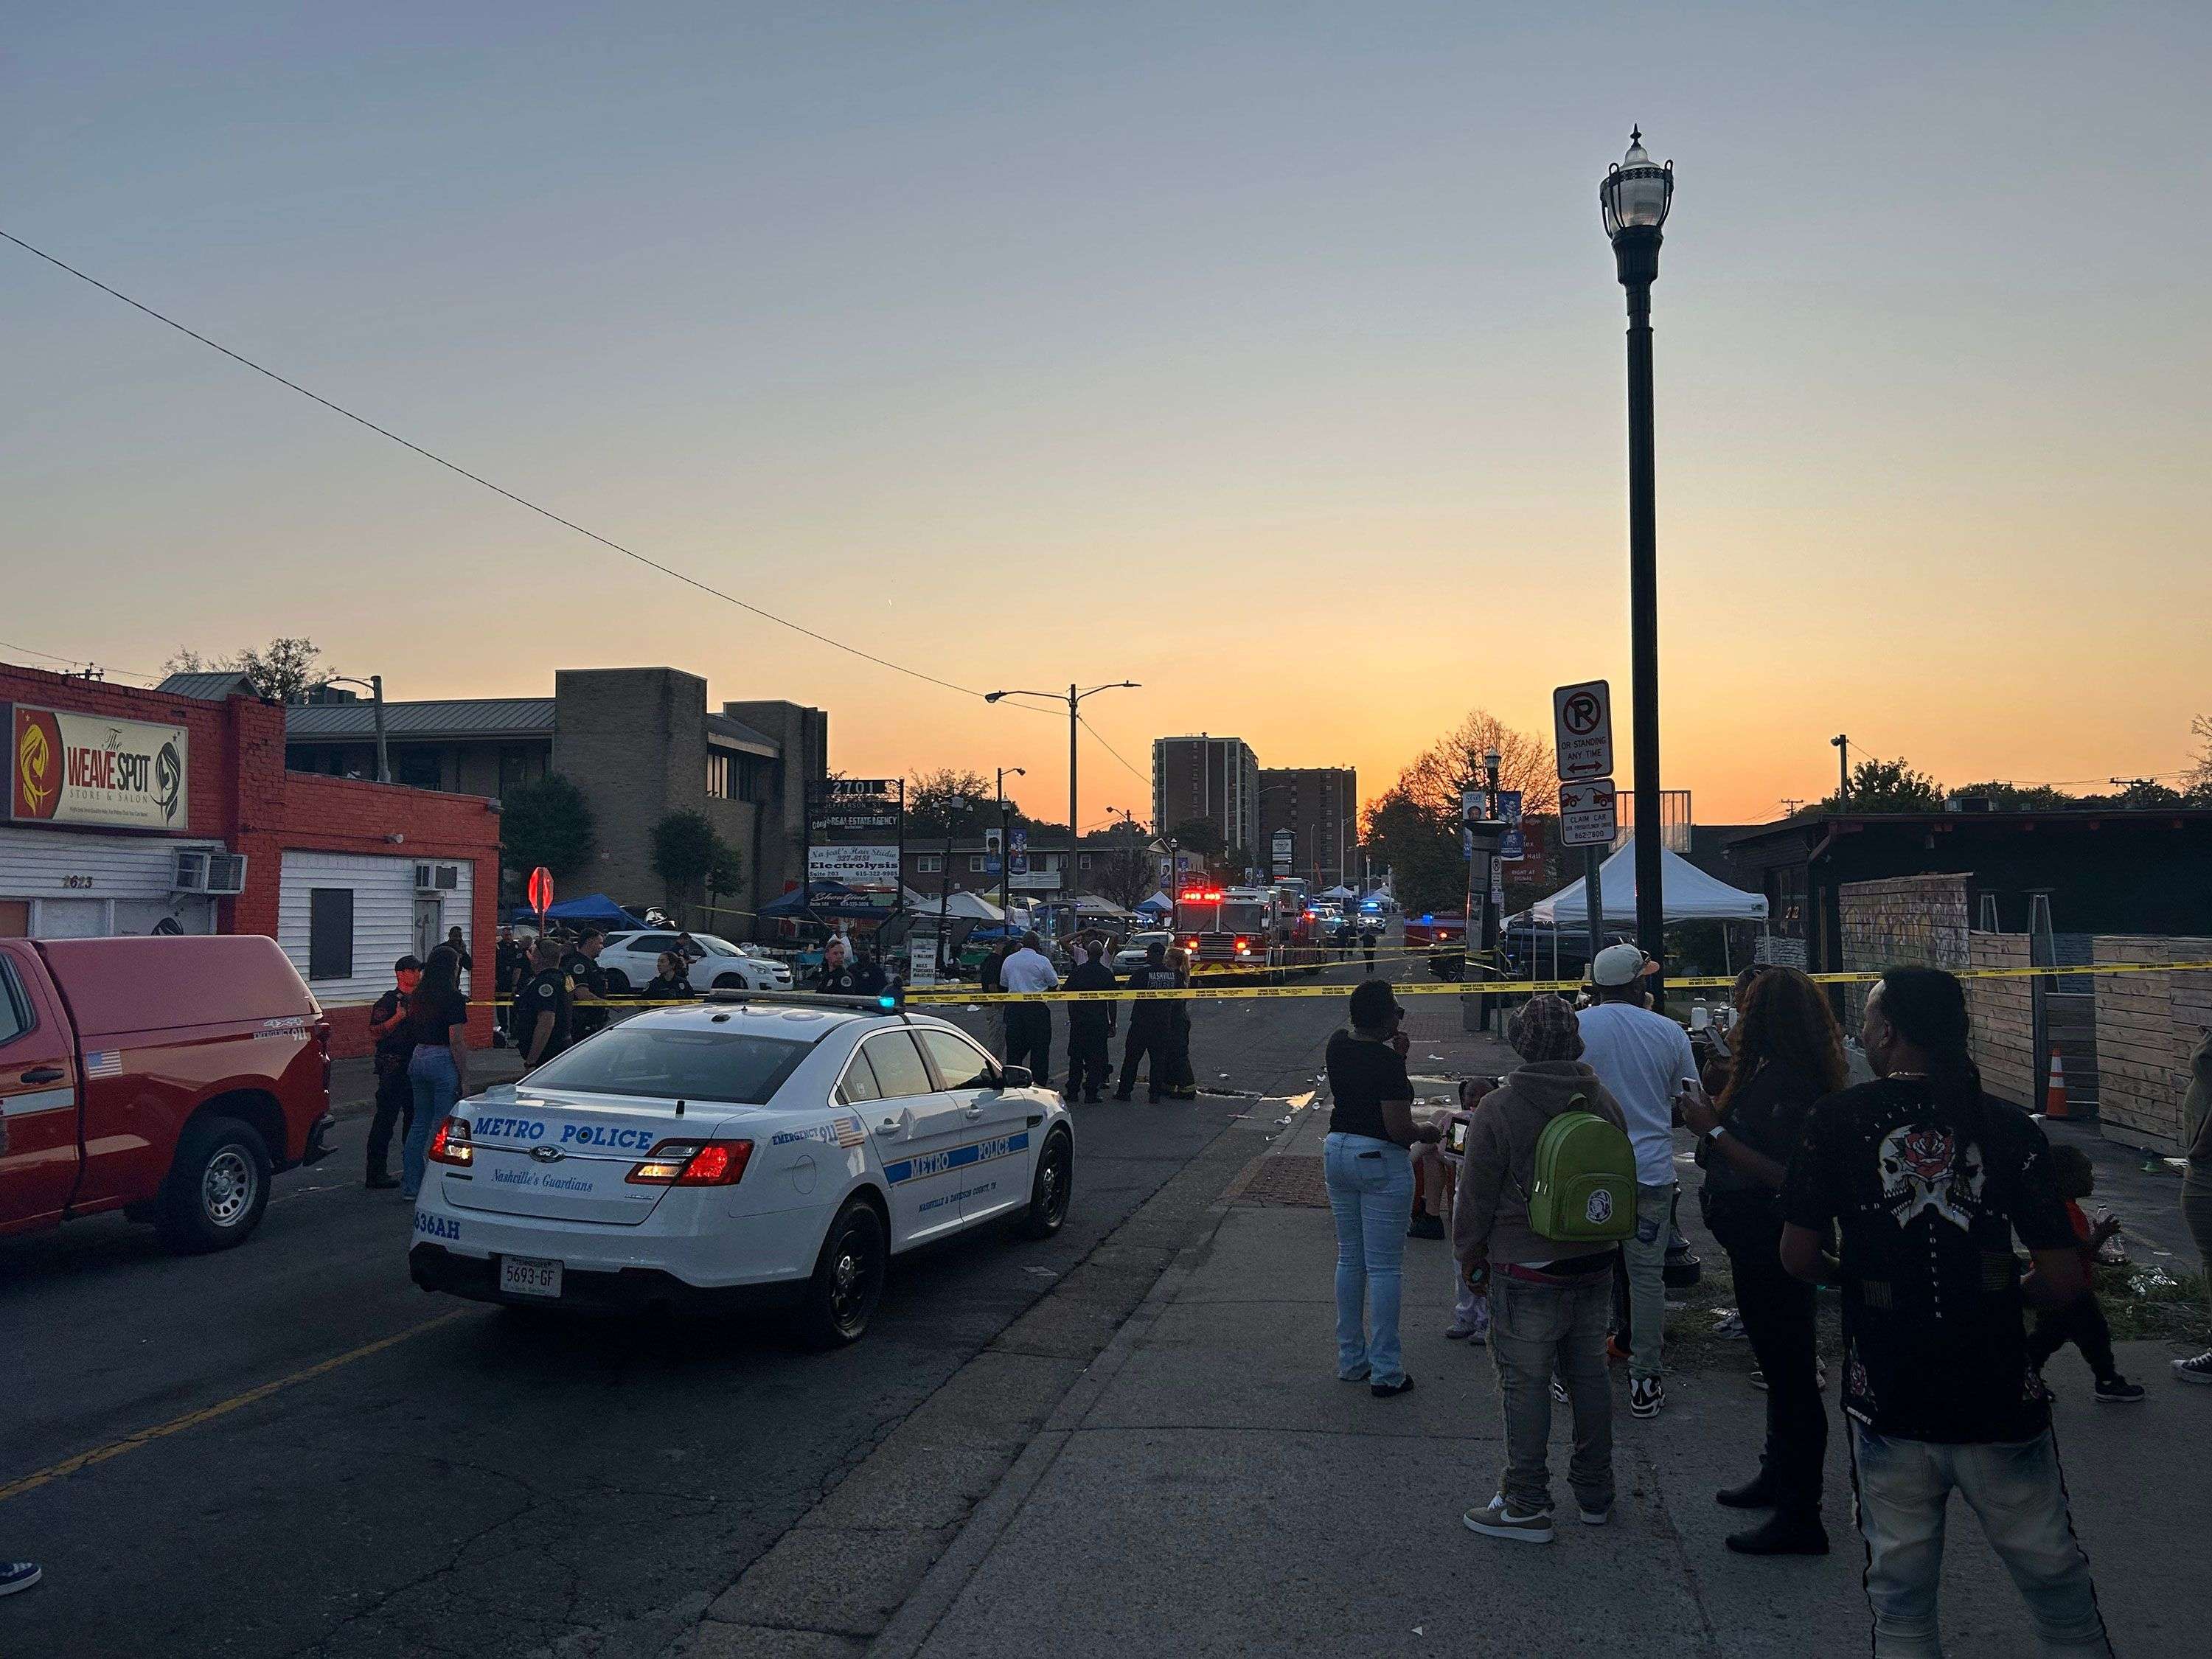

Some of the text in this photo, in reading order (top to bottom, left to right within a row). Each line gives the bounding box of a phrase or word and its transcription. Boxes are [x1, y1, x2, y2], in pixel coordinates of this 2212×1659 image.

[102, 728, 122, 751] The
[1562, 737, 1606, 750] OR STANDING
[1568, 749, 1602, 760] ANY TIME
[67, 747, 150, 792] WEAVE SPOT
[833, 782, 874, 793] 2701
[70, 790, 147, 803] STORE & SALON
[810, 861, 898, 870] Electrolysis
[1149, 972, 1175, 980] NASHVILLE
[473, 1117, 654, 1150] METRO POLICE
[772, 1124, 838, 1145] EMERGENCY 911
[538, 1147, 554, 1157] Ford
[910, 1137, 1010, 1178] METRO POLICE
[492, 1169, 593, 1192] Nashville's Guardians
[919, 1197, 945, 1213] NASHVILLE
[507, 1265, 554, 1287] 5693-GF
